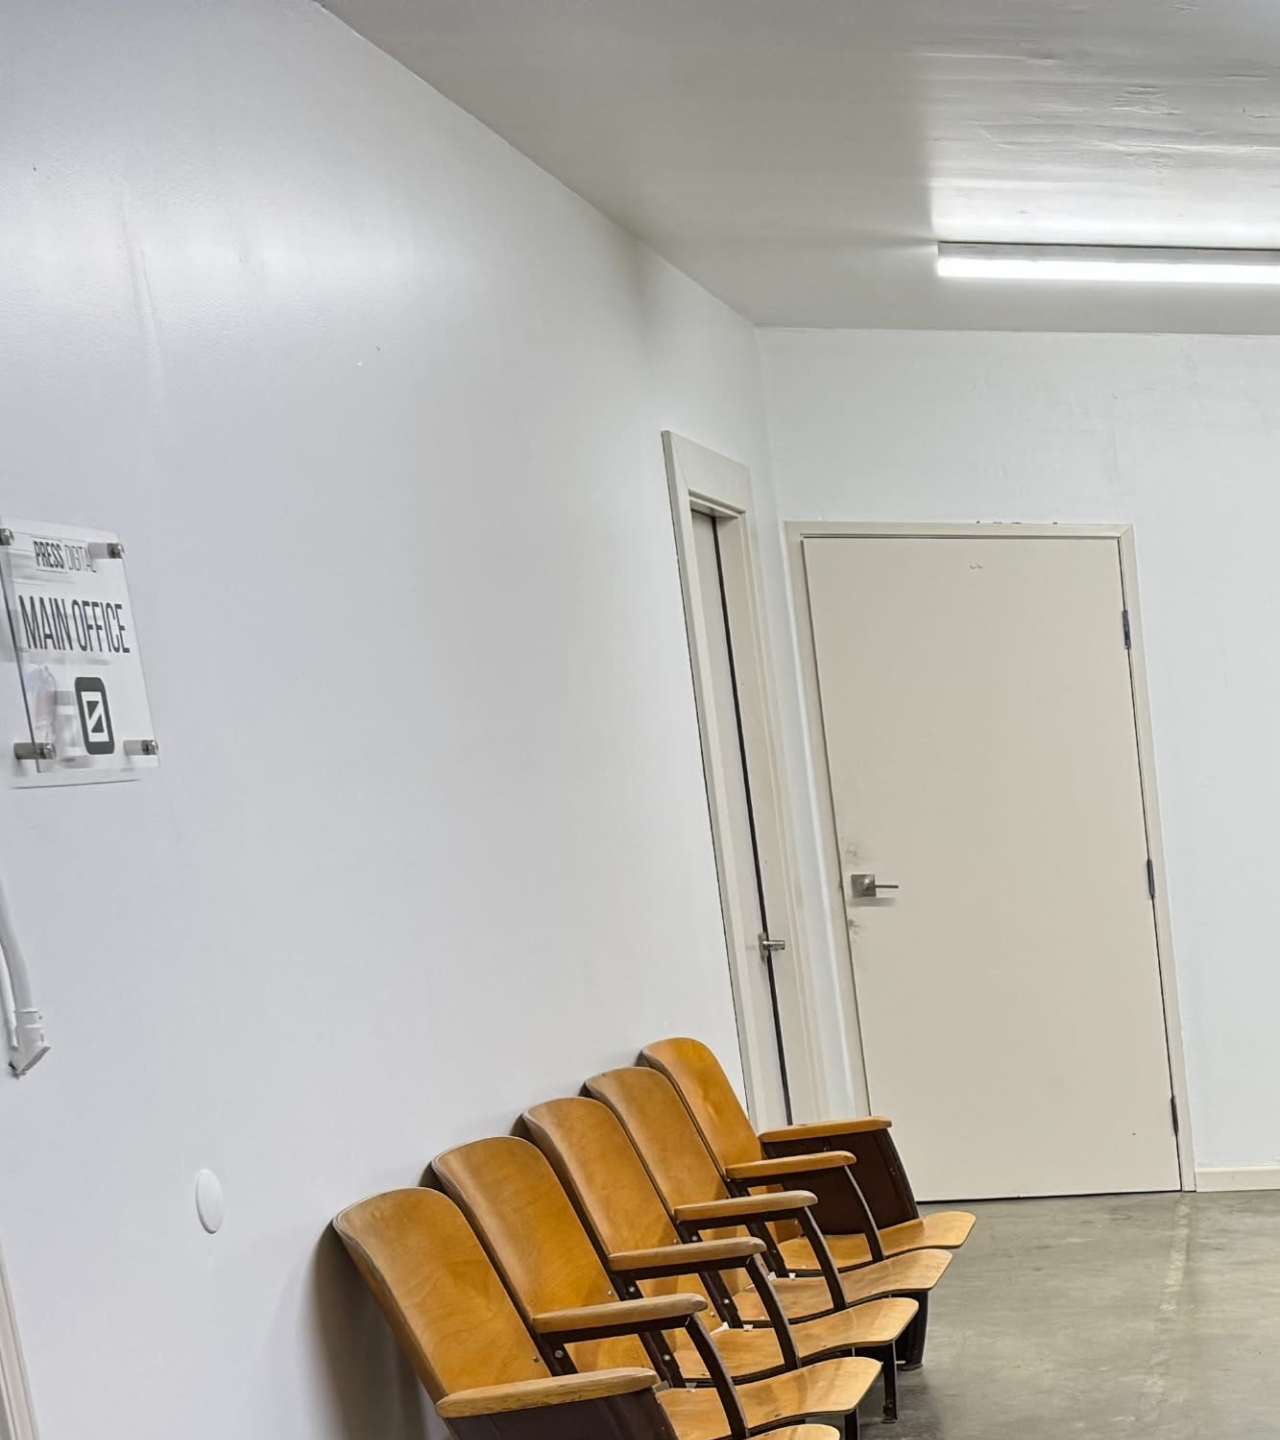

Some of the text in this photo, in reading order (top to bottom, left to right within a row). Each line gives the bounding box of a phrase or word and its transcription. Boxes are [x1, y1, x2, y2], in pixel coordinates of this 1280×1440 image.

[33, 540, 65, 569] PRESS
[18, 595, 130, 654] MAIN OFFICE
